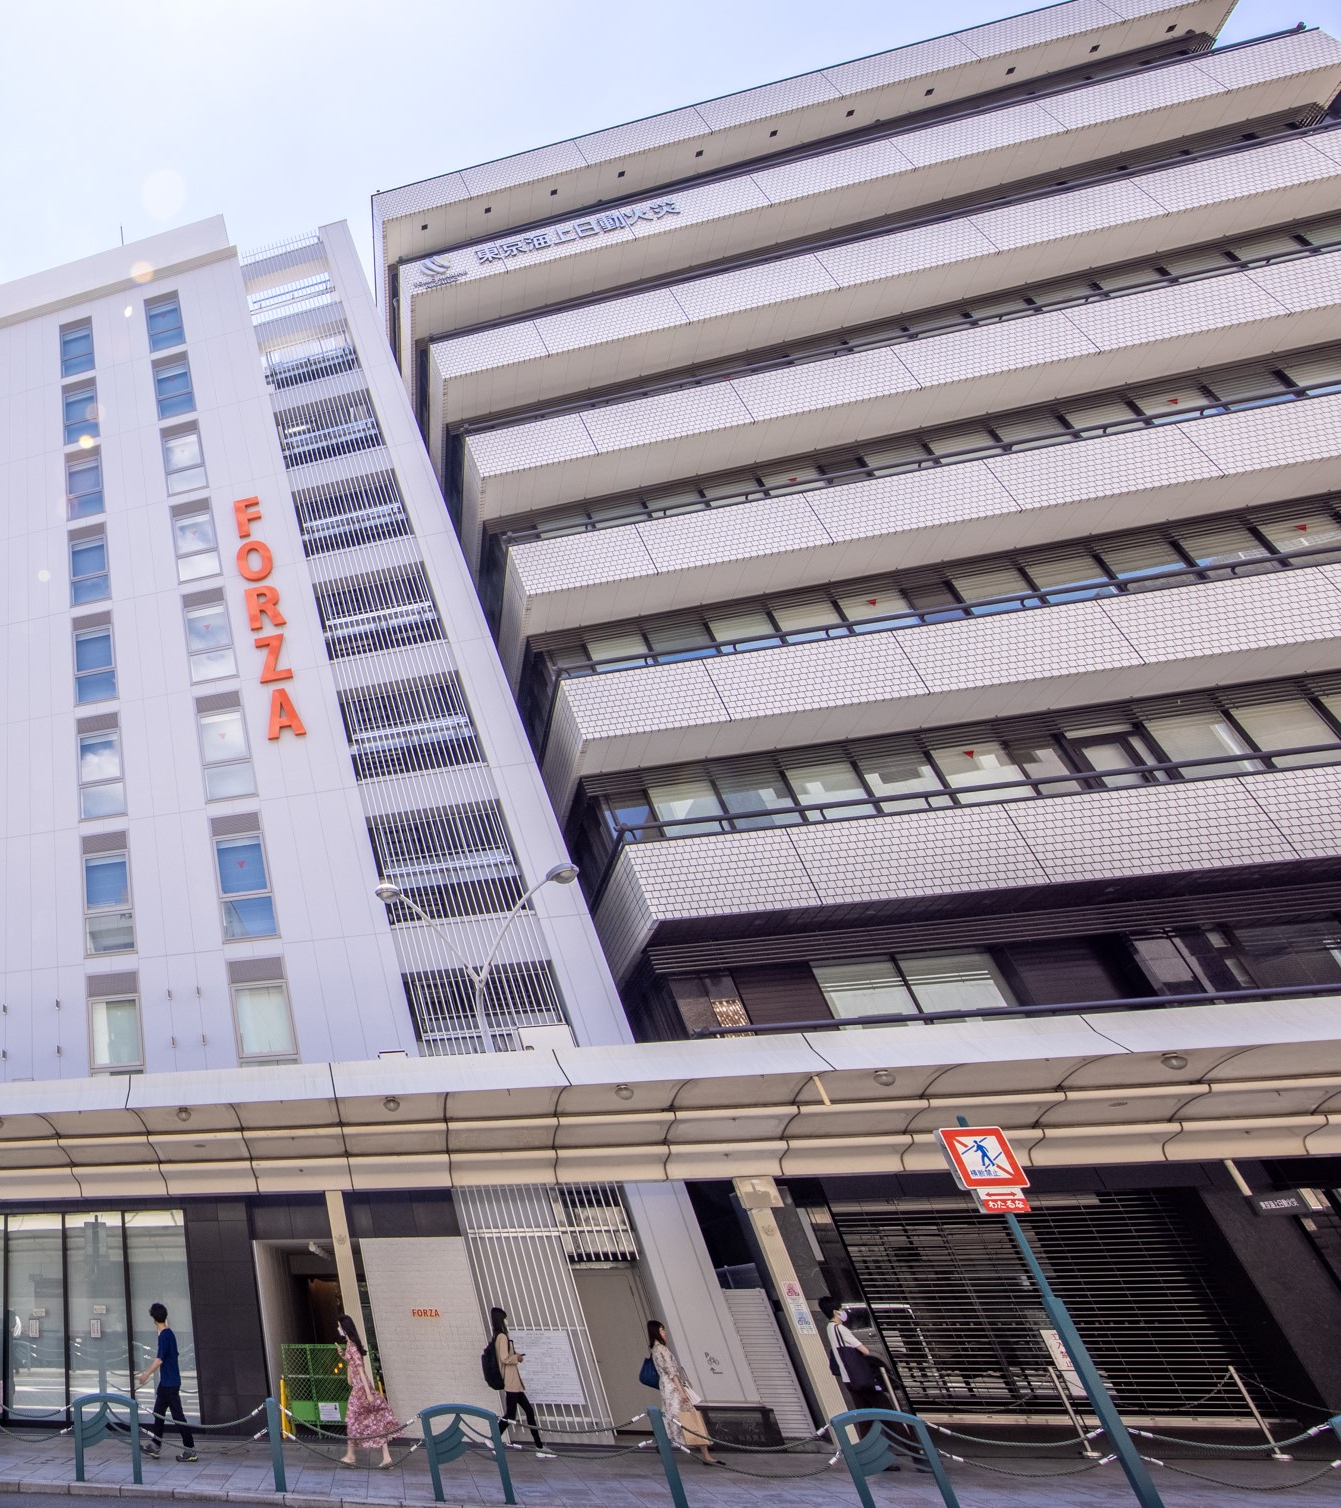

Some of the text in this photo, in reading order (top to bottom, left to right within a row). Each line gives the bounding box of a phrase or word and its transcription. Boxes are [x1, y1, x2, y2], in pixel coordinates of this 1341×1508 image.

[475, 200, 681, 264] 東京海上日動火災
[233, 496, 306, 740] FORZA
[970, 1169, 1001, 1177] 横断禁止
[988, 1199, 1025, 1209] わたるな
[412, 1309, 440, 1317] FORZA
